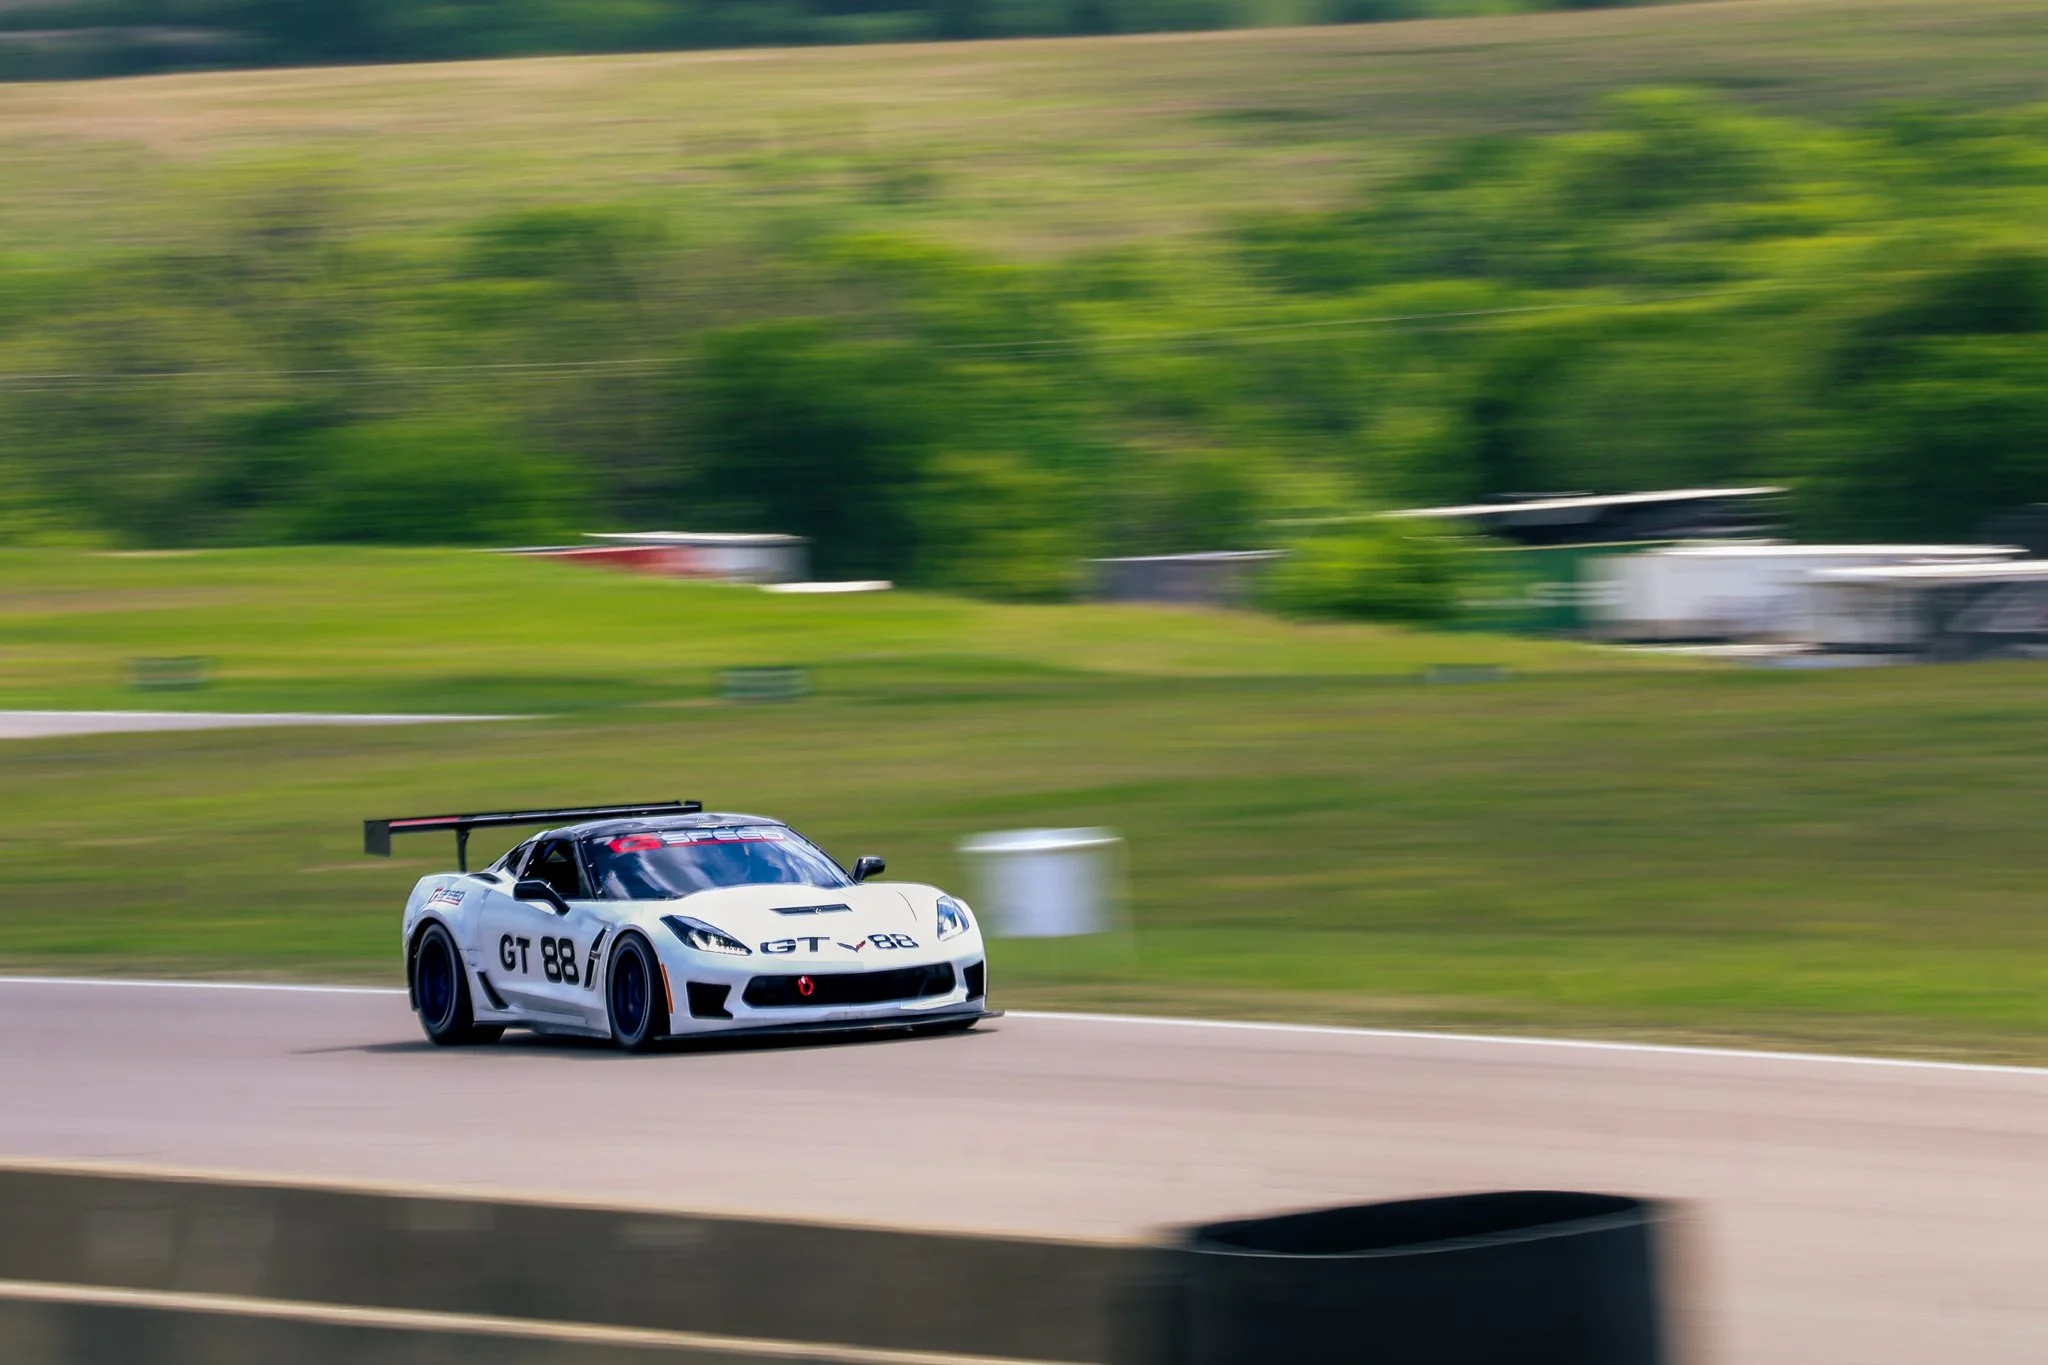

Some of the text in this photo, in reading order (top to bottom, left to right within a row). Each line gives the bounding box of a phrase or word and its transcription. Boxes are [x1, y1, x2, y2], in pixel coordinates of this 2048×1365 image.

[499, 933, 580, 986] GT 88
[760, 933, 919, 955] GT 88
